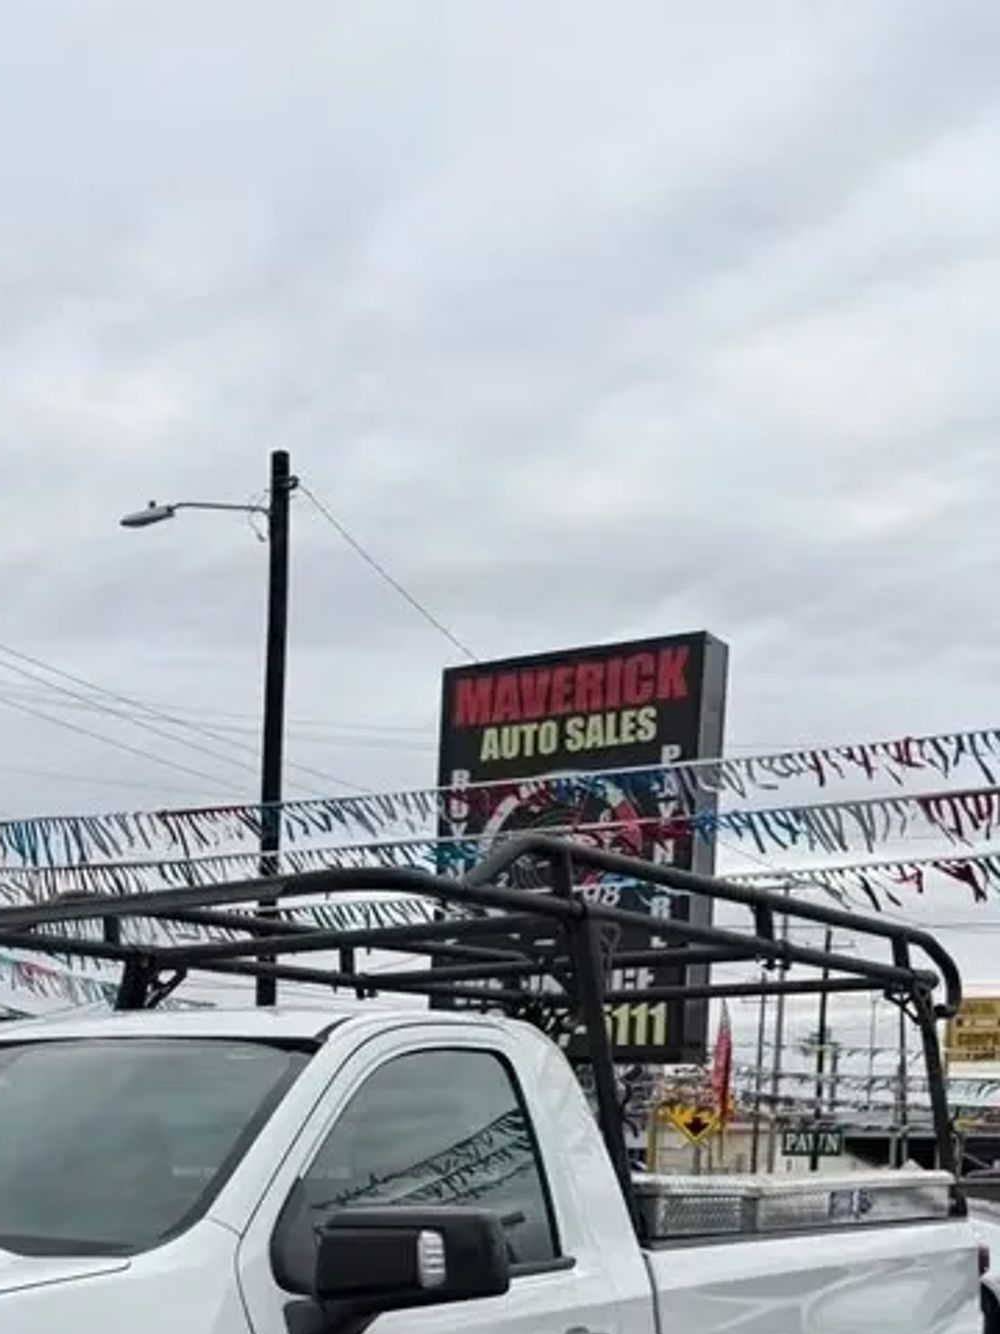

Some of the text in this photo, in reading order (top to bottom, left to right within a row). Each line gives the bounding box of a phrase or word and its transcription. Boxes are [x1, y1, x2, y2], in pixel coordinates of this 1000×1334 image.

[455, 646, 689, 729] MAVERICK
[480, 706, 658, 763] AUTO SALES
